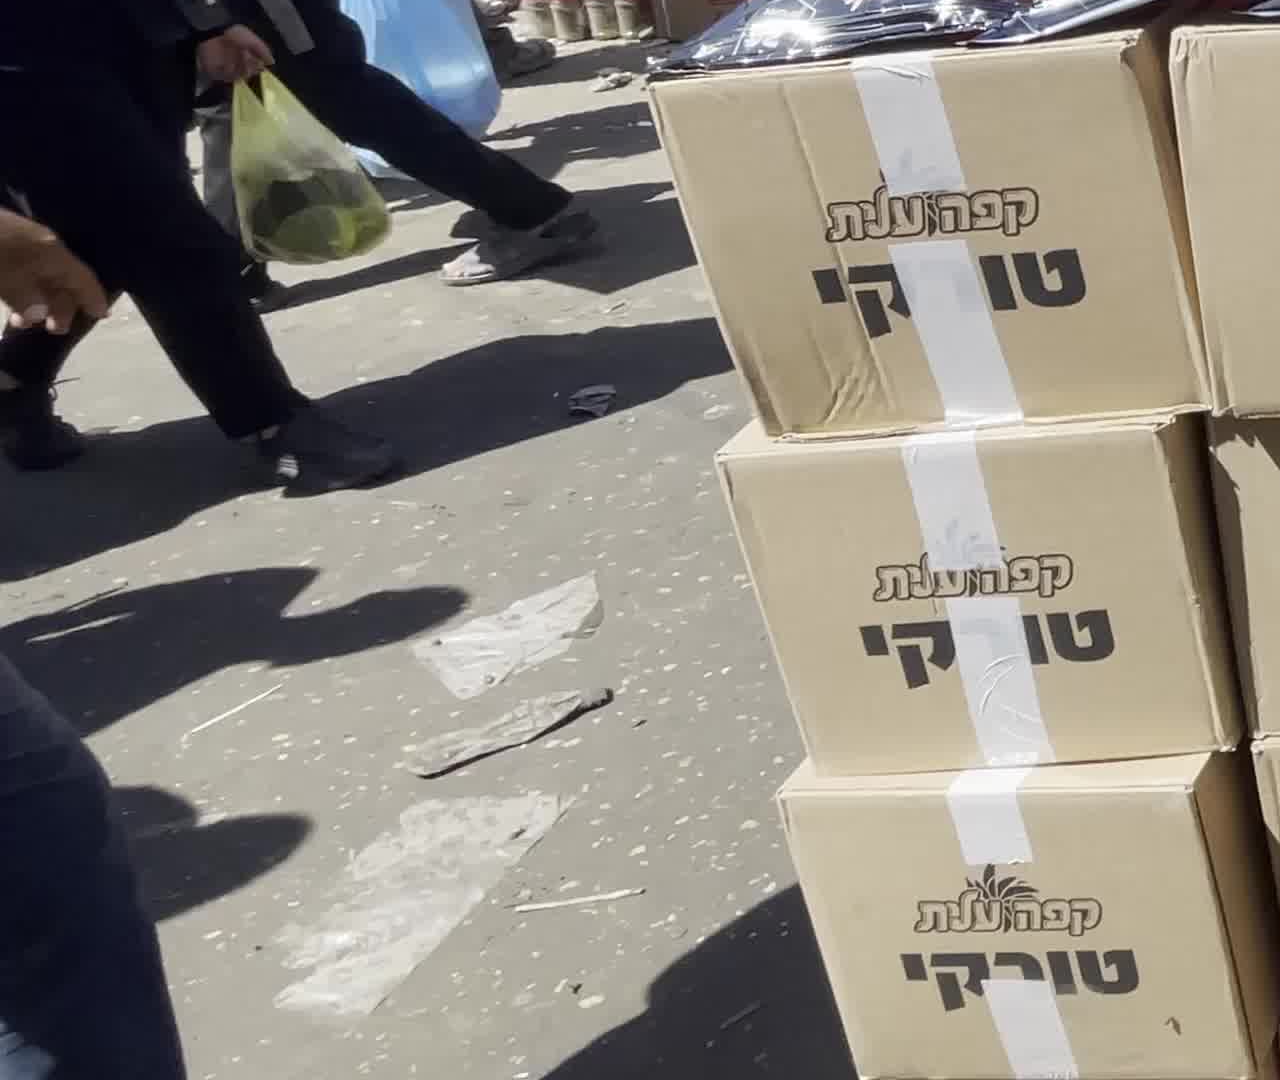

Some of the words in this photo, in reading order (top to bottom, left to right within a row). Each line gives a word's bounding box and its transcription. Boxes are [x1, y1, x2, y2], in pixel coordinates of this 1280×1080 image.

[936, 186, 1039, 237] קפה
[811, 248, 1087, 339] טוקי
[859, 608, 1116, 690] טוקי
[913, 887, 1003, 934] עלית
[1013, 897, 1103, 937] קפה
[899, 949, 1141, 1013] טורקי
